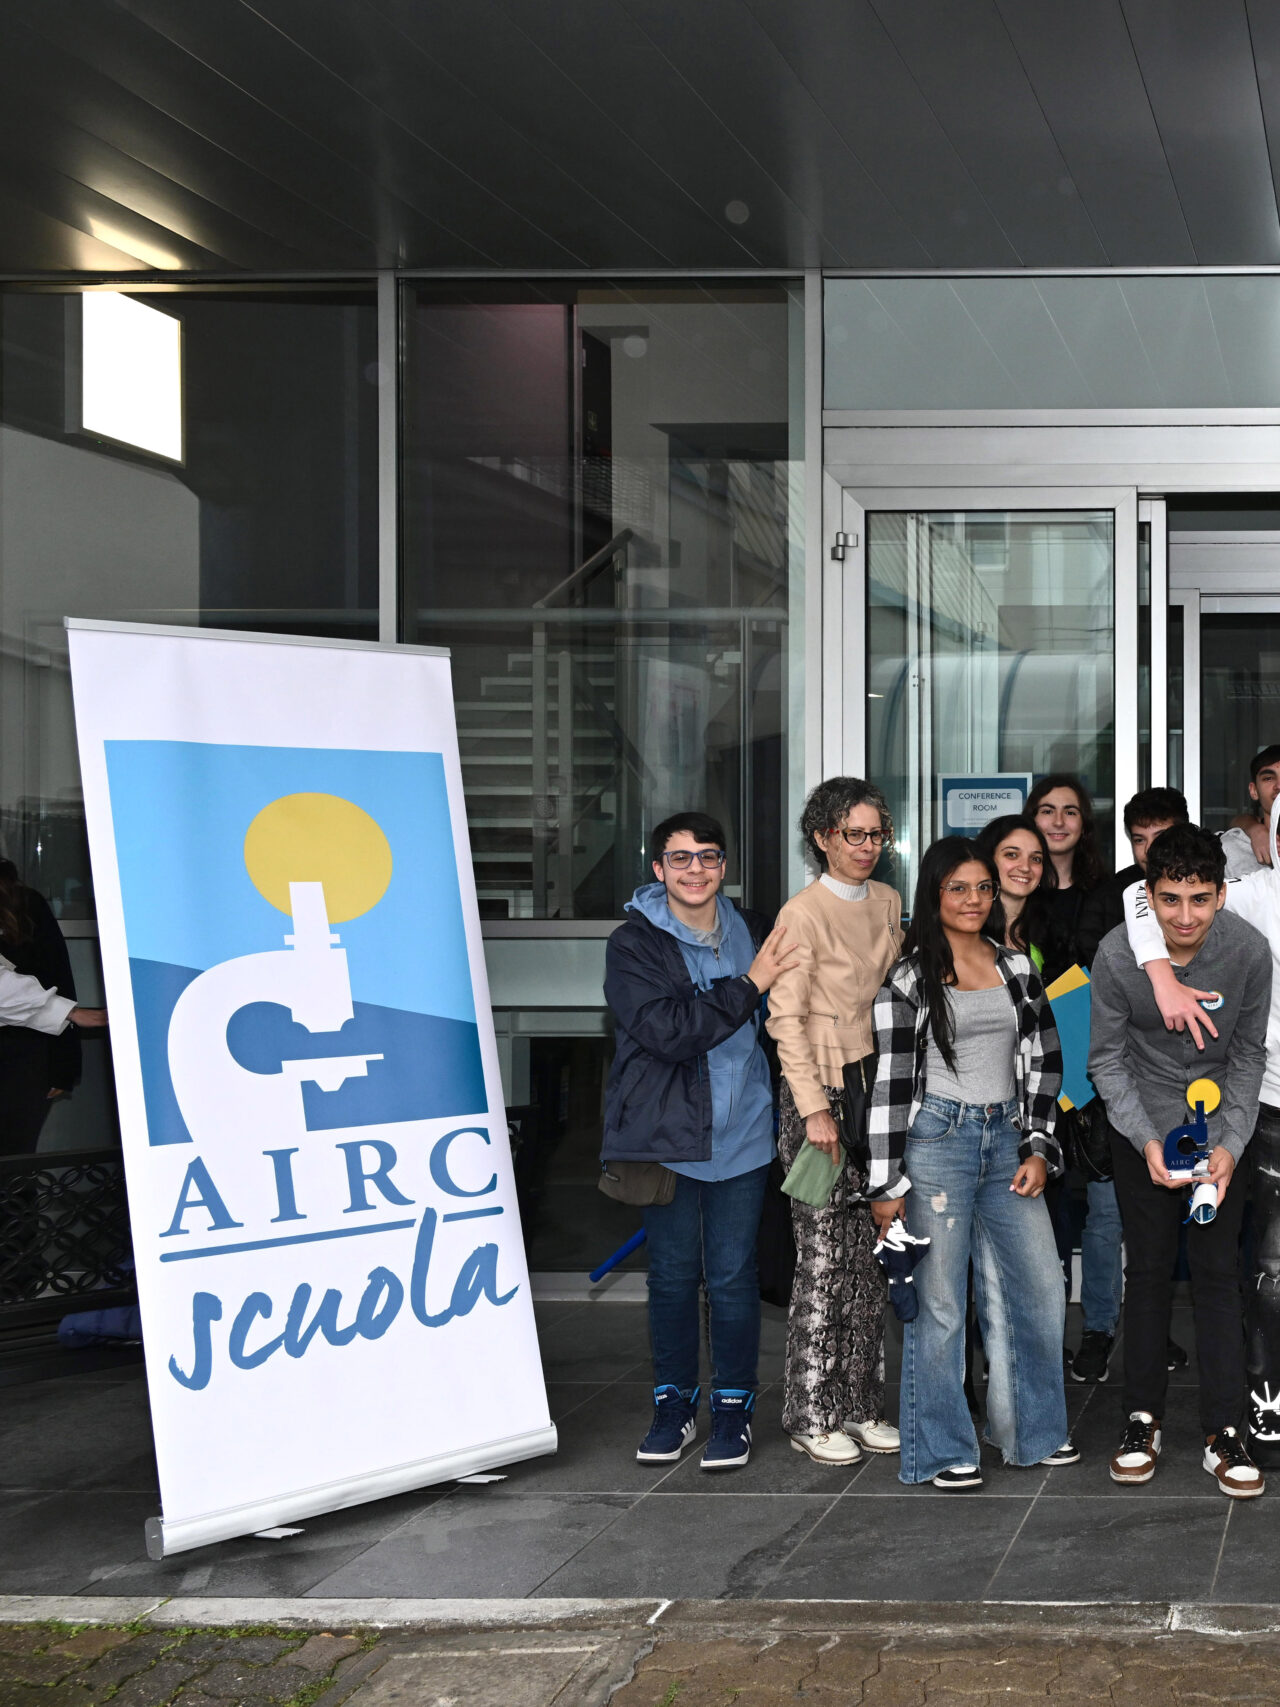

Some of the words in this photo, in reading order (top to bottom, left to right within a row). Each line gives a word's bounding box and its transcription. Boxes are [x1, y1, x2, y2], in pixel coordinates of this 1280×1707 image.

[958, 792, 1012, 800] CONFERENCE
[159, 1127, 498, 1238] AIRC
[168, 1207, 520, 1391] scuola
